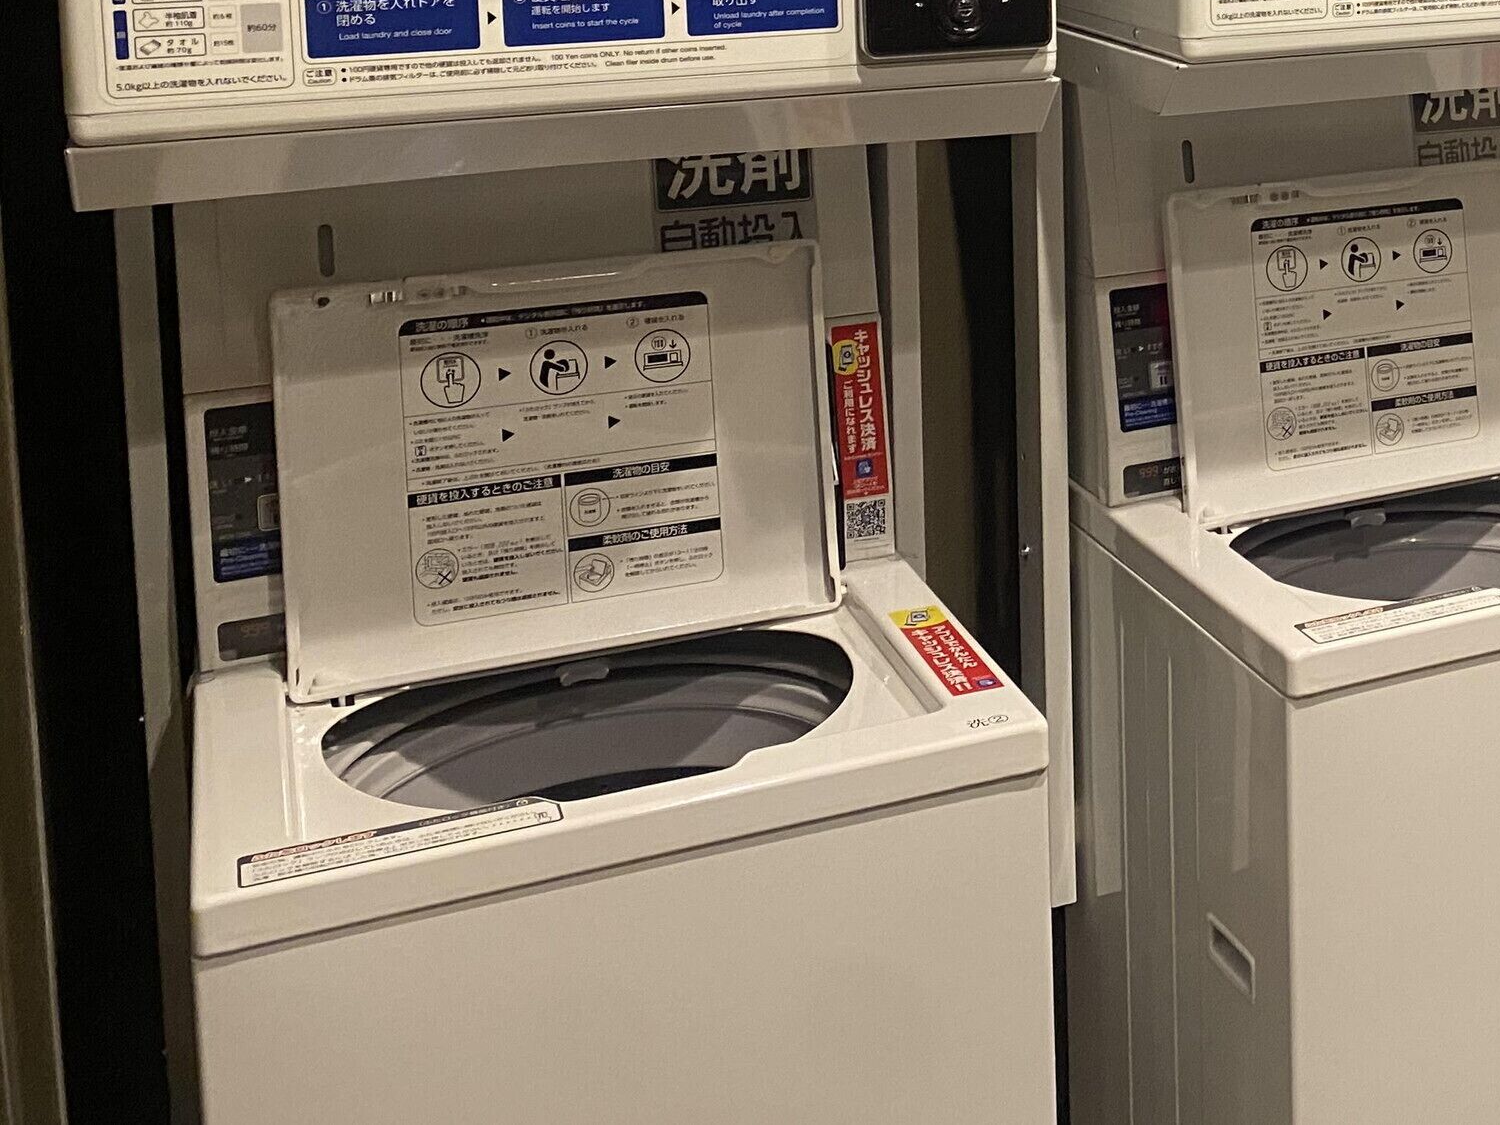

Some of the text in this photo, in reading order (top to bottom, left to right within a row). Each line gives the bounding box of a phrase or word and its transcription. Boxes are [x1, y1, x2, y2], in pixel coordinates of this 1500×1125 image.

[317, 0, 332, 15] ①
[530, 2, 610, 16] 運転を開始します
[336, 13, 376, 27] 閉める
[393, 30, 409, 38] and
[116, 73, 288, 92] 5.0kg以上の洗濯物を入れないでください。
[854, 329, 876, 451] キャッシュレス決済
[612, 461, 671, 479] 洗濯物の目安
[416, 477, 554, 506] 硬貨を投入するときのご注意
